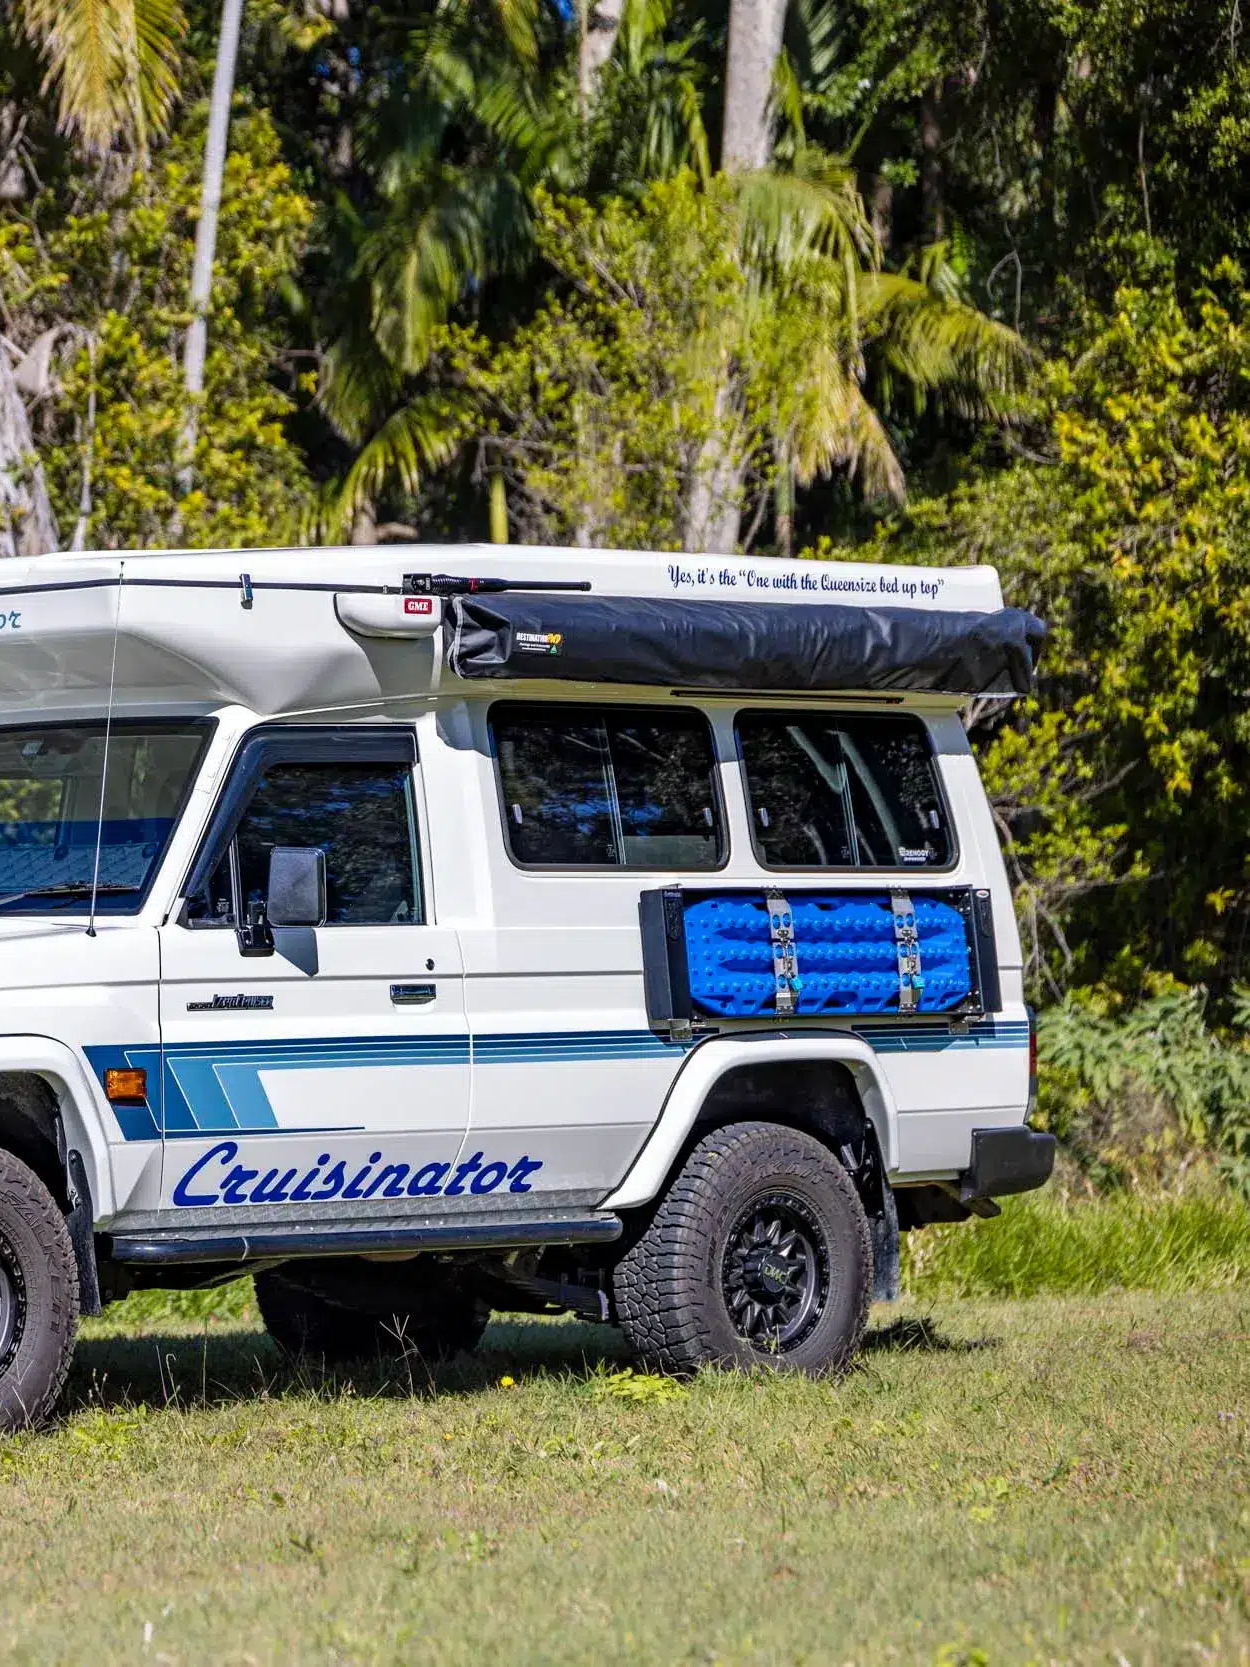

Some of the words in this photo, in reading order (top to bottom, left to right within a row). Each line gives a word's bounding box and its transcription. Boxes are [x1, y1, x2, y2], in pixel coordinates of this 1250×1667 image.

[668, 565, 695, 588] Yes,
[698, 568, 715, 584] it's
[719, 569, 737, 585] the
[773, 573, 797, 589] with
[801, 573, 818, 590] the
[821, 574, 877, 592] Queensize
[880, 576, 899, 592] bed
[902, 581, 917, 598] up
[408, 602, 429, 611] GME
[173, 1141, 543, 1207] Cruisinator
